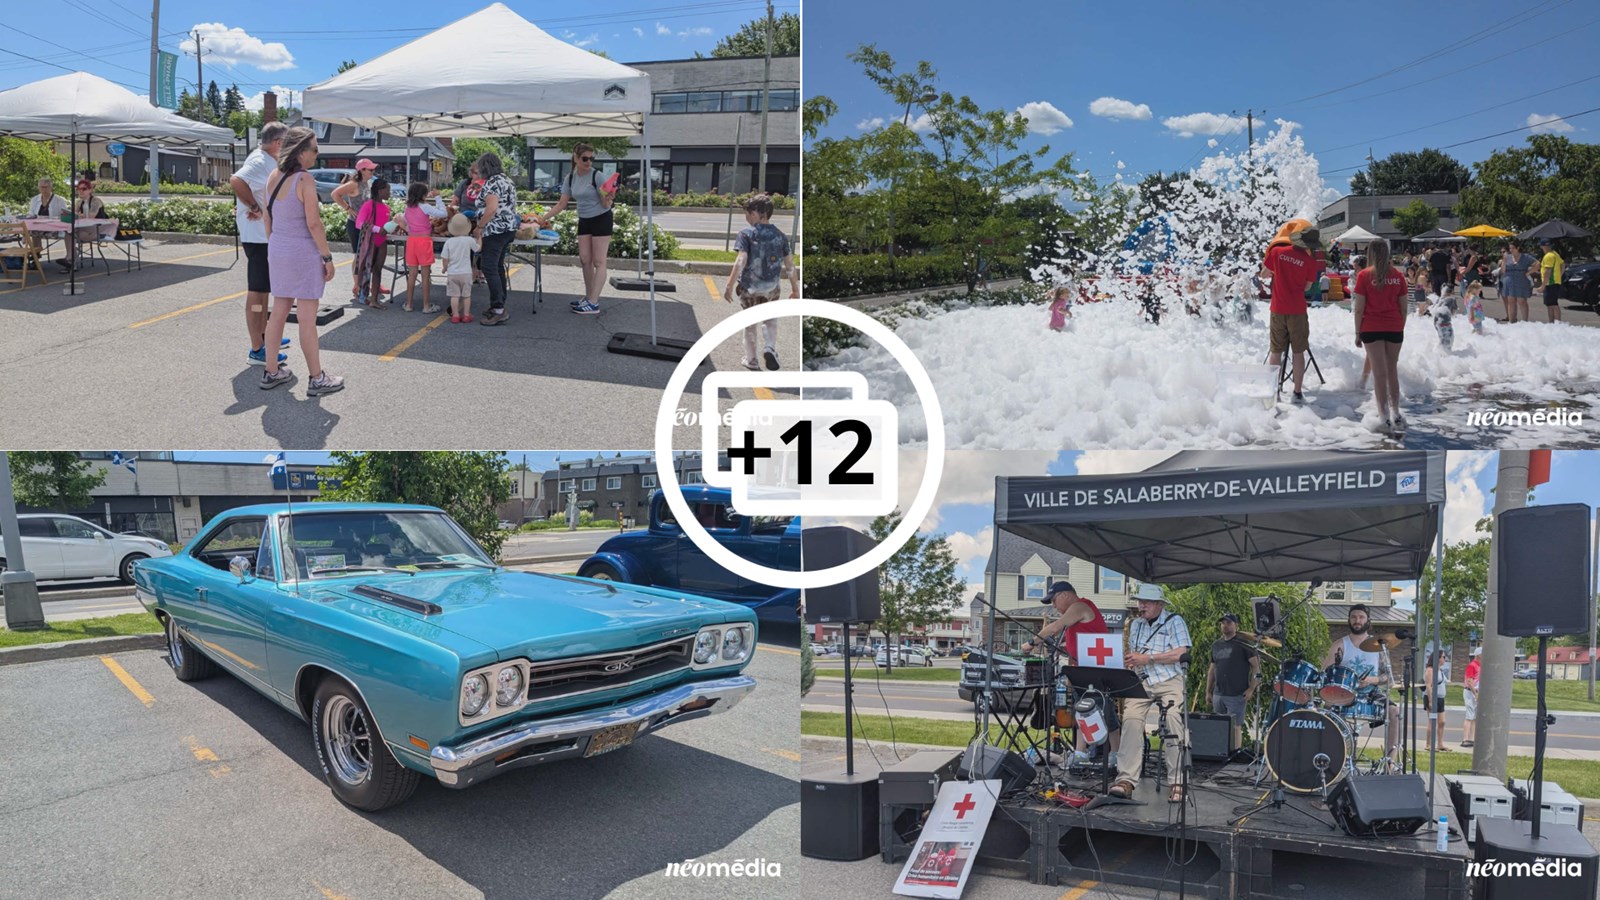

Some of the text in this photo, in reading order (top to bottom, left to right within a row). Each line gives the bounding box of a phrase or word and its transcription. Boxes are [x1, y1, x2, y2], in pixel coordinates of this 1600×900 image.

[1279, 254, 1305, 267] CULTURE
[1024, 491, 1069, 508] VILLE
[1075, 489, 1098, 506] DE
[1104, 470, 1386, 505] SALABERRY-DE-VALLEYFIELD
[605, 660, 631, 672] GTX
